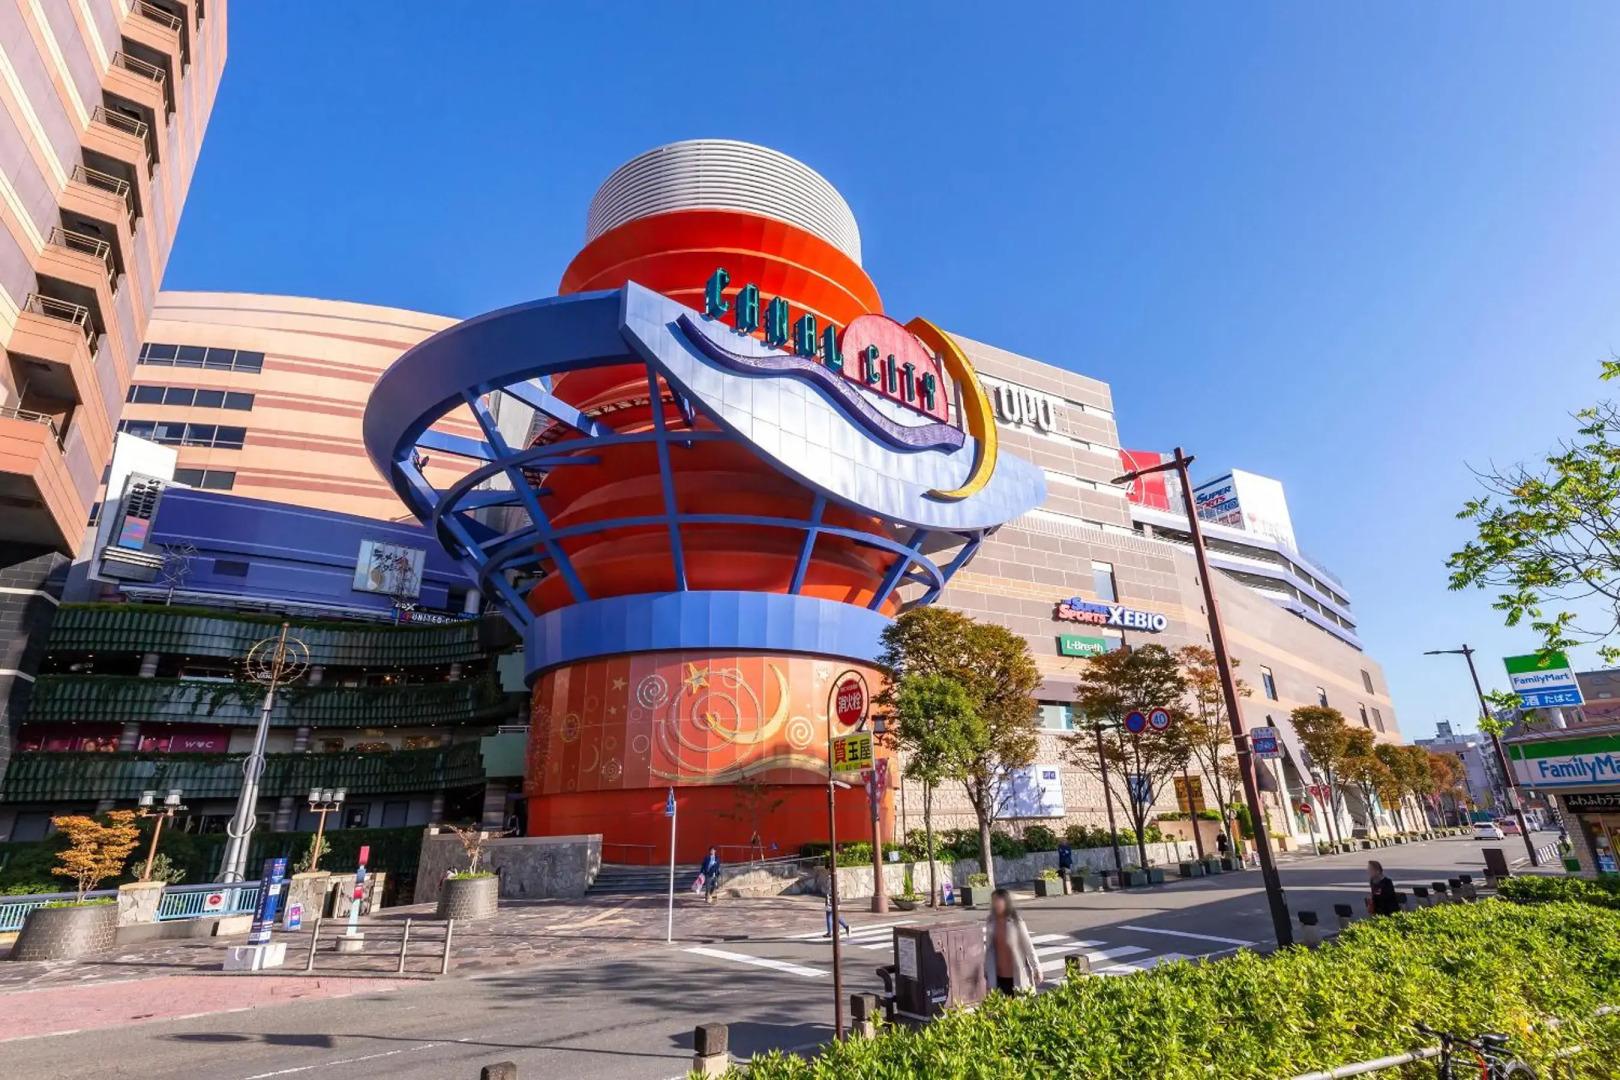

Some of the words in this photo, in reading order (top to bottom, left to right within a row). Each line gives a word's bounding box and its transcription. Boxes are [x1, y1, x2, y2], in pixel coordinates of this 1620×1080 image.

[706, 267, 843, 372] CANAL
[865, 344, 935, 410] CITY
[1196, 485, 1232, 504] SUPER
[411, 613, 442, 624] UNITED
[1058, 603, 1107, 624] SPORTS
[1108, 606, 1168, 630] XEBIO
[1066, 639, 1104, 653] L-Breath
[1513, 672, 1570, 685] FamilyMart
[838, 692, 862, 713] 消火栓
[1525, 695, 1540, 706] 酒
[1544, 693, 1575, 704] たばこ
[1153, 713, 1166, 725] 40
